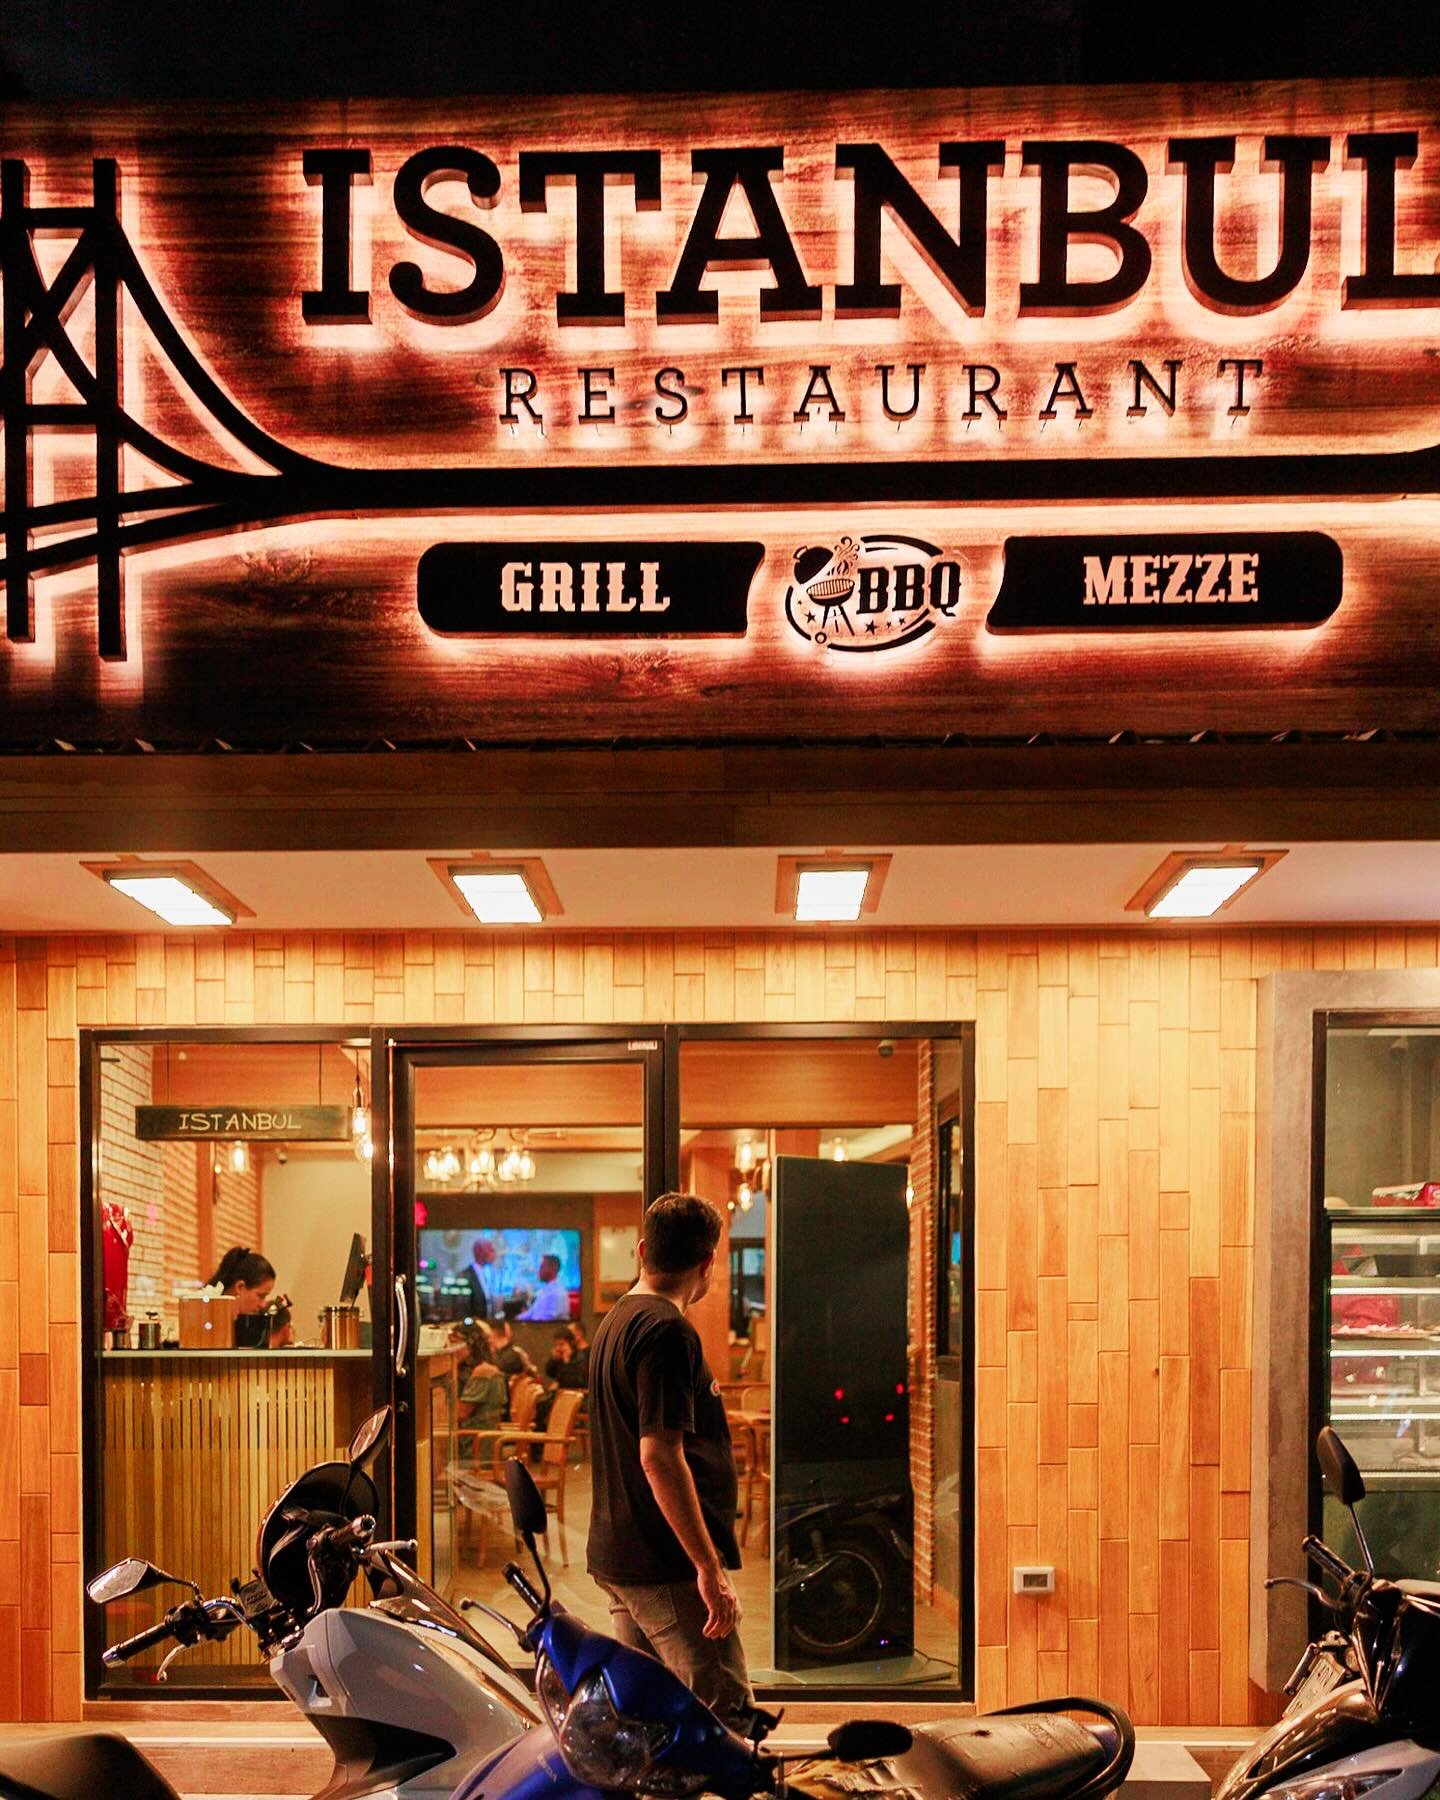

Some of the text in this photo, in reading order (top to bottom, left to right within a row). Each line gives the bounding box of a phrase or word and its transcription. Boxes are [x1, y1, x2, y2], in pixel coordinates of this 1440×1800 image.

[301, 132, 1440, 328] ISTANBUL
[499, 358, 1263, 425] RESTAURANT
[500, 562, 670, 612] GRILL
[856, 561, 962, 617] BBQ
[1083, 553, 1259, 605] MEZZE
[178, 1112, 302, 1131] ISTANBUL
